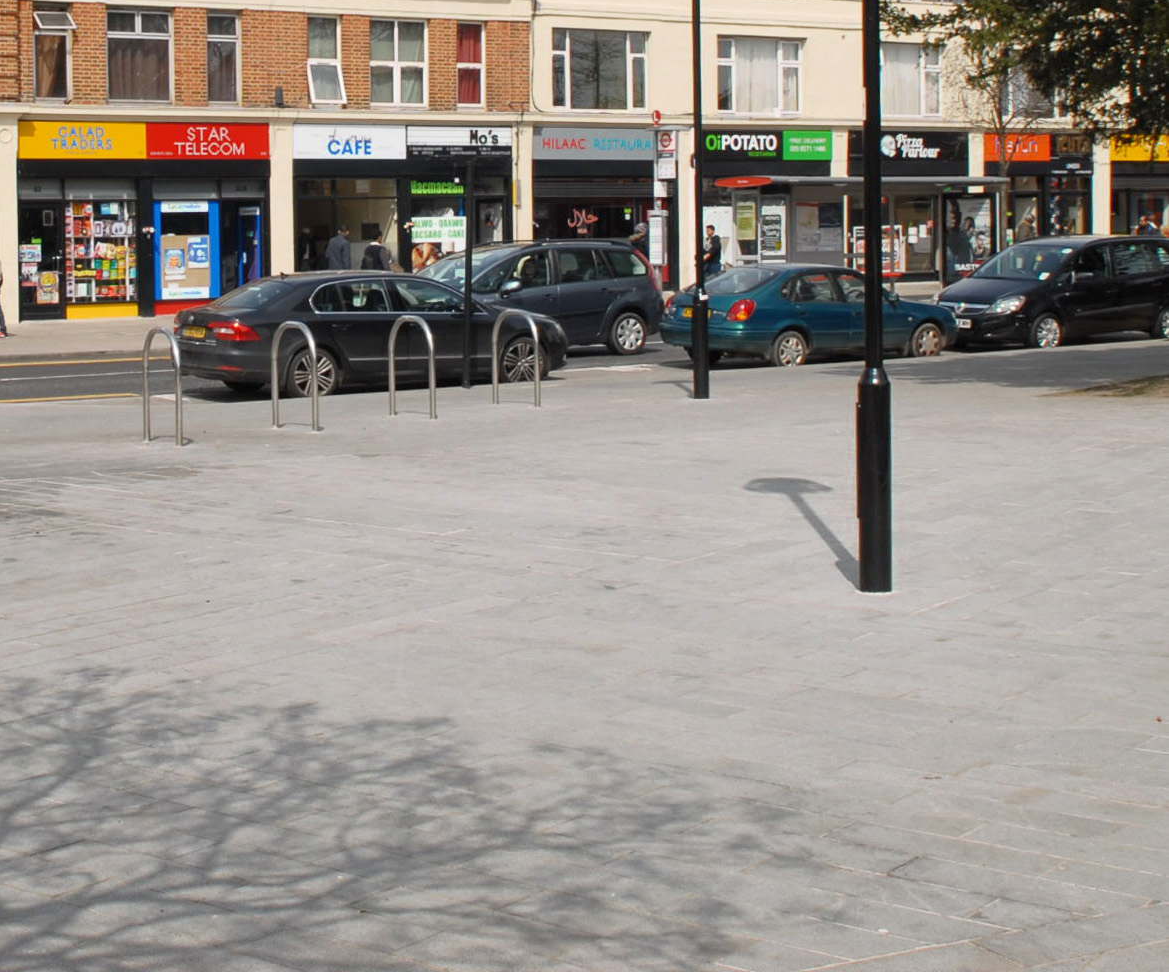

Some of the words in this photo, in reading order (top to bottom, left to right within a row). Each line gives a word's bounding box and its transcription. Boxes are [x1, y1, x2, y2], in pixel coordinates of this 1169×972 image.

[187, 126, 231, 141] STAR
[470, 129, 499, 145] Mo's
[895, 133, 924, 148] Pizza
[51, 138, 113, 150] TRADERS
[174, 141, 246, 156] TELECOM
[327, 140, 372, 155] CAFE
[542, 138, 587, 149] HILAAC
[593, 137, 653, 150] RESTAURA
[901, 146, 940, 158] Parlour
